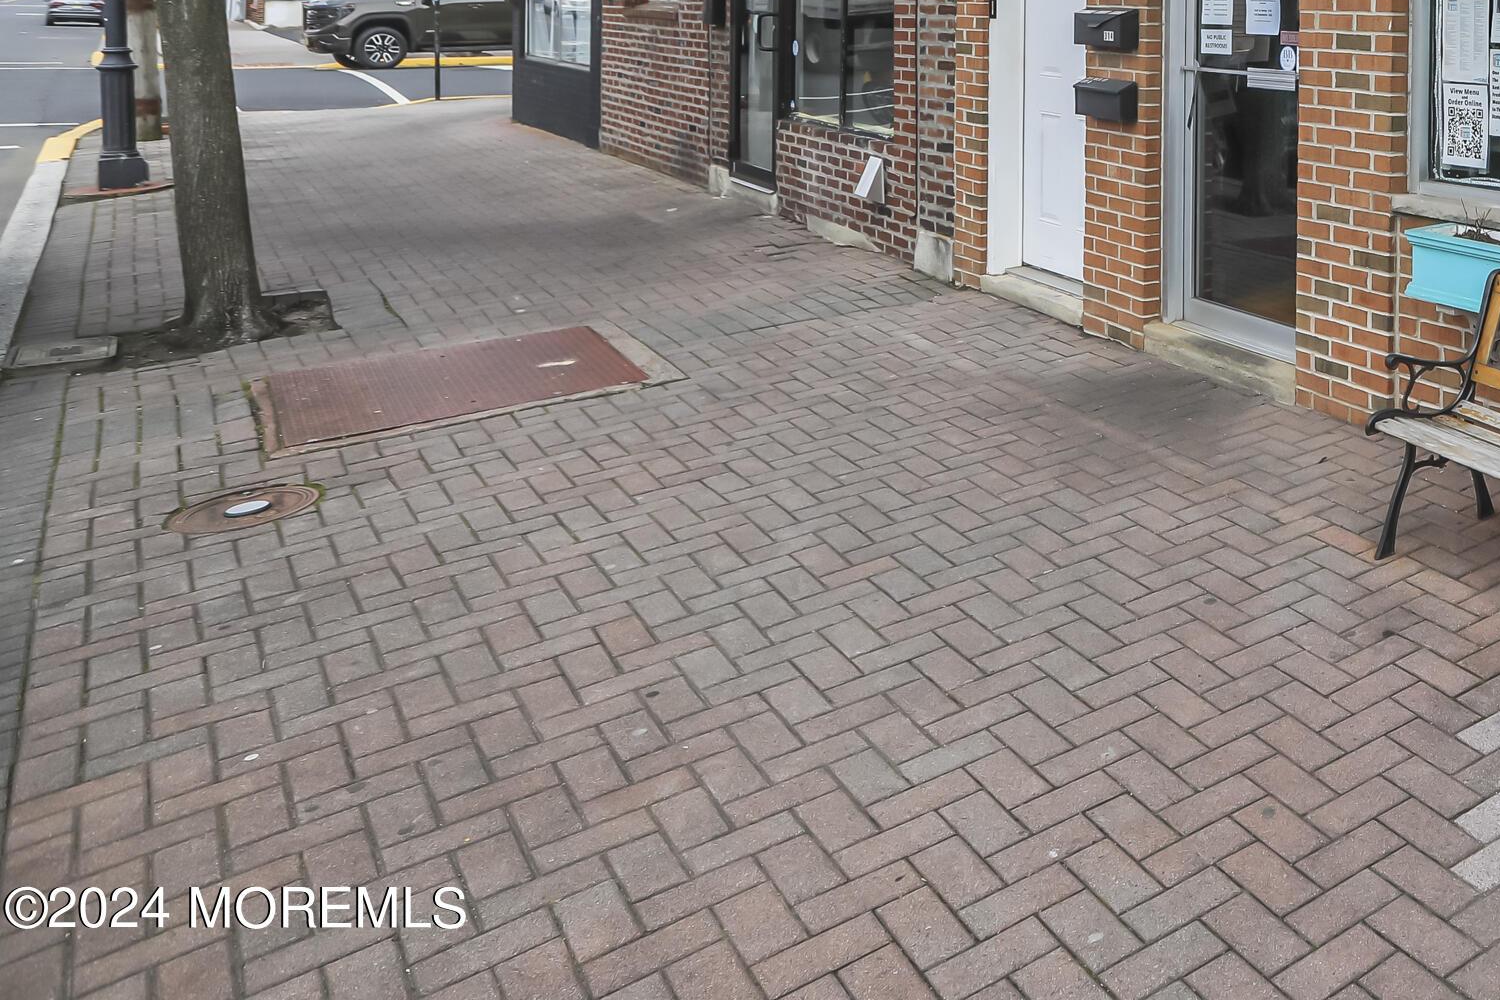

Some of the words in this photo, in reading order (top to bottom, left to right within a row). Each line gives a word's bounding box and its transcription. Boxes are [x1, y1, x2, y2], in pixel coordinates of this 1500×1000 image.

[1449, 87, 1463, 95] View
[1464, 88, 1480, 96] Menu
[1447, 98, 1463, 106] Order
